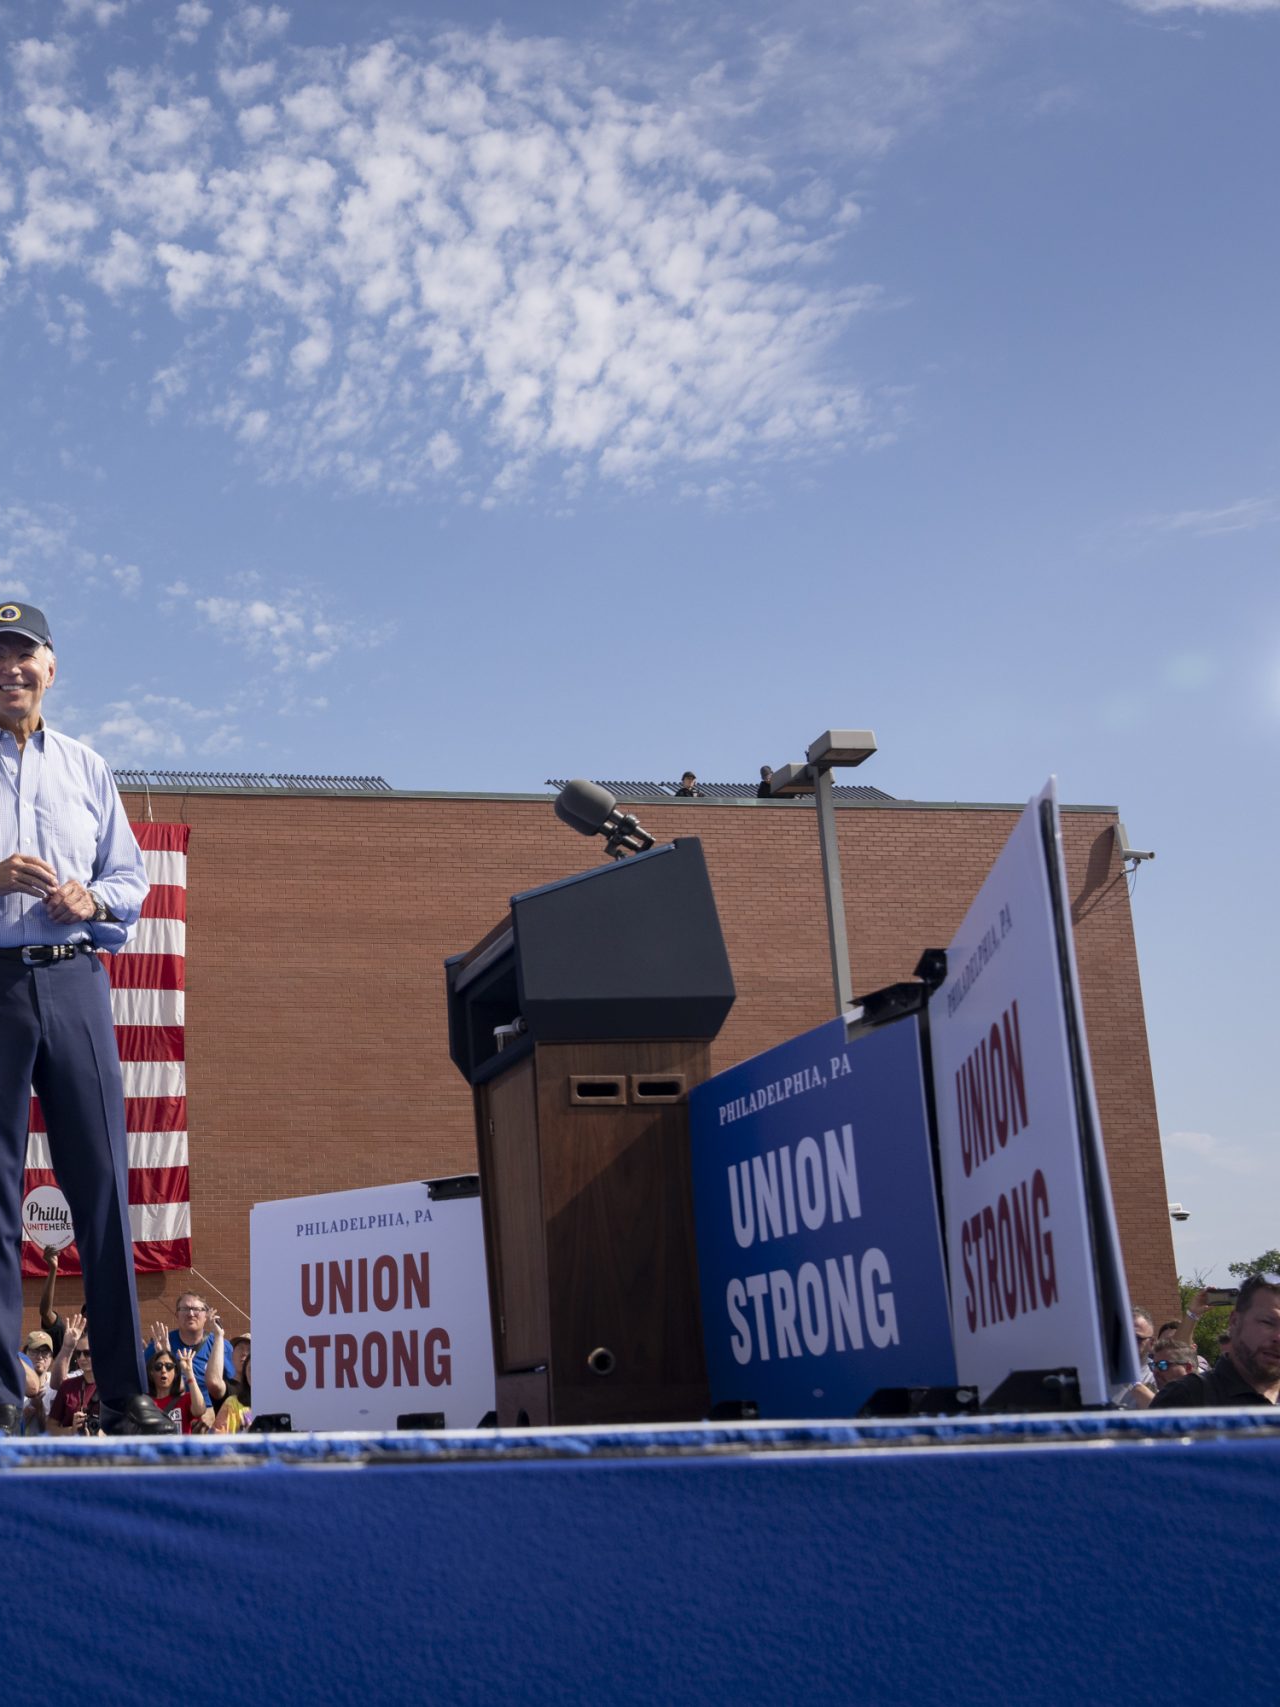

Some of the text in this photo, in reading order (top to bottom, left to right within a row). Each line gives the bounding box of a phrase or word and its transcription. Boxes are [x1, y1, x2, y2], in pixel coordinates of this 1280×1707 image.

[718, 1053, 852, 1126] PHILADELPHIA, PA
[954, 999, 1030, 1178] UNION
[26, 1201, 68, 1224] Philly
[296, 1208, 433, 1237] PHILADELPHIA, PA
[727, 1124, 861, 1249] UNION
[301, 1251, 430, 1317] UNION
[961, 1168, 1058, 1334] STRONG
[726, 1247, 900, 1365] STRONG
[284, 1327, 452, 1391] STRONG
